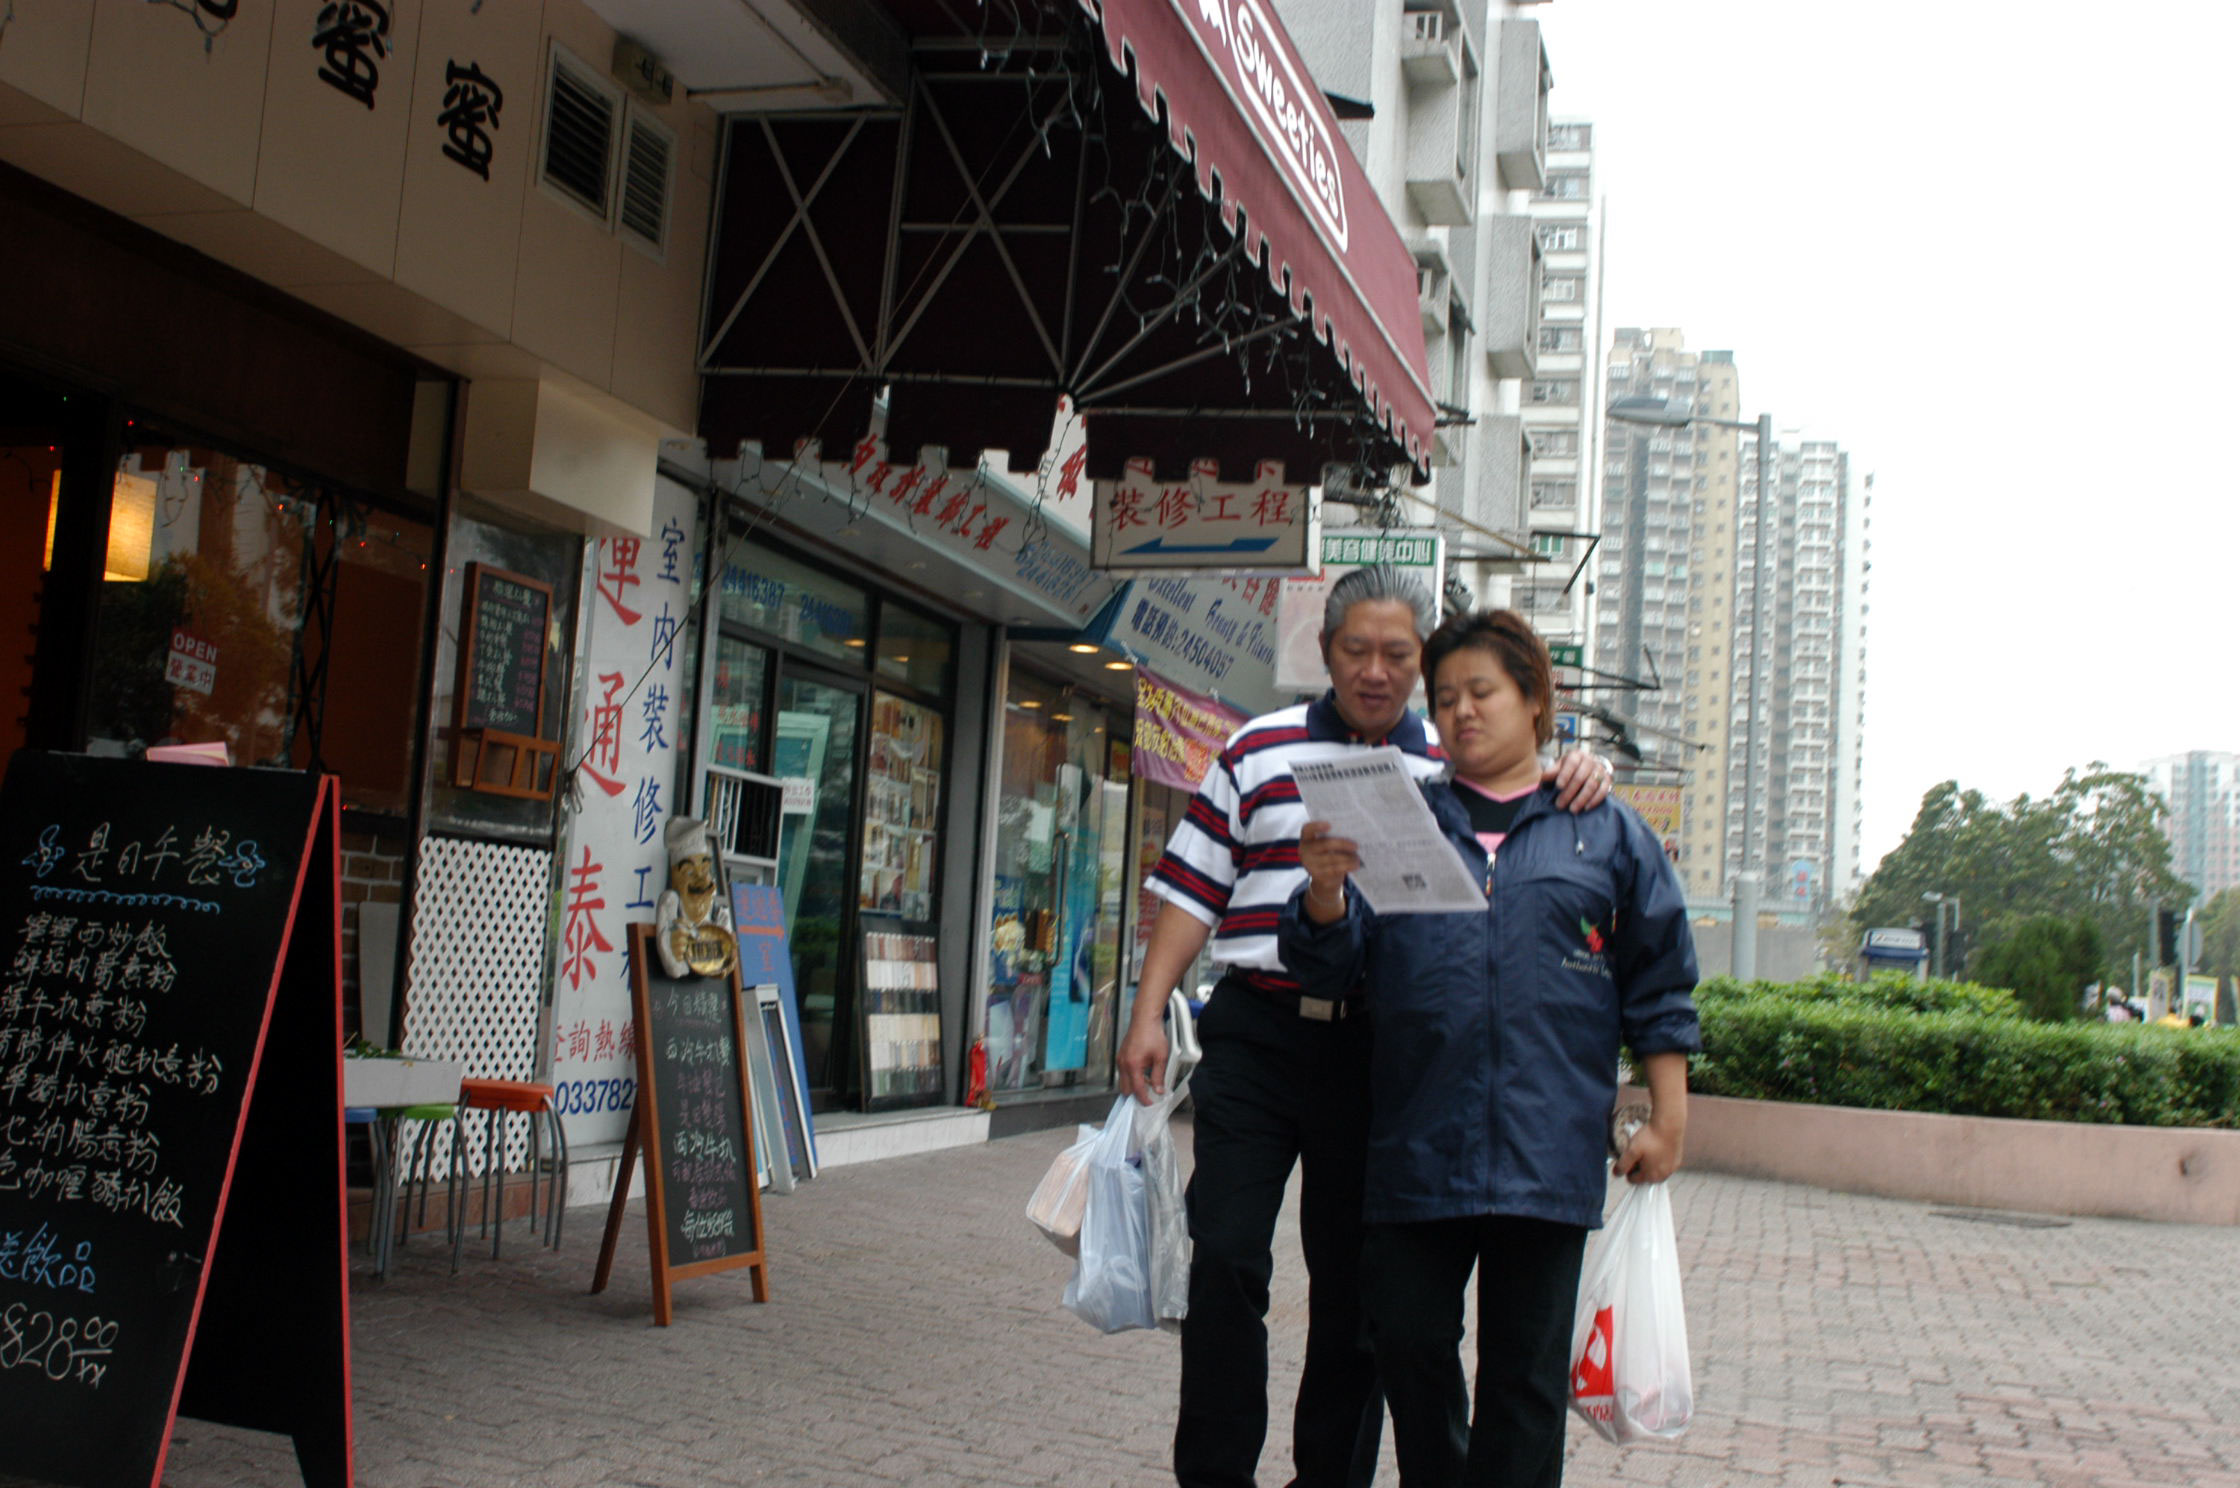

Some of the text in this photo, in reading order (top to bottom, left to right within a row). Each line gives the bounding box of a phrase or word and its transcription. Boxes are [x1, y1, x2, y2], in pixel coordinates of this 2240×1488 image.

[1236, 2, 1338, 219] Sweeties
[1107, 486, 1293, 531] 裝修工程
[174, 632, 217, 663] OPEN
[169, 657, 212, 688] 營業中
[72, 821, 231, 886] 是日午餐
